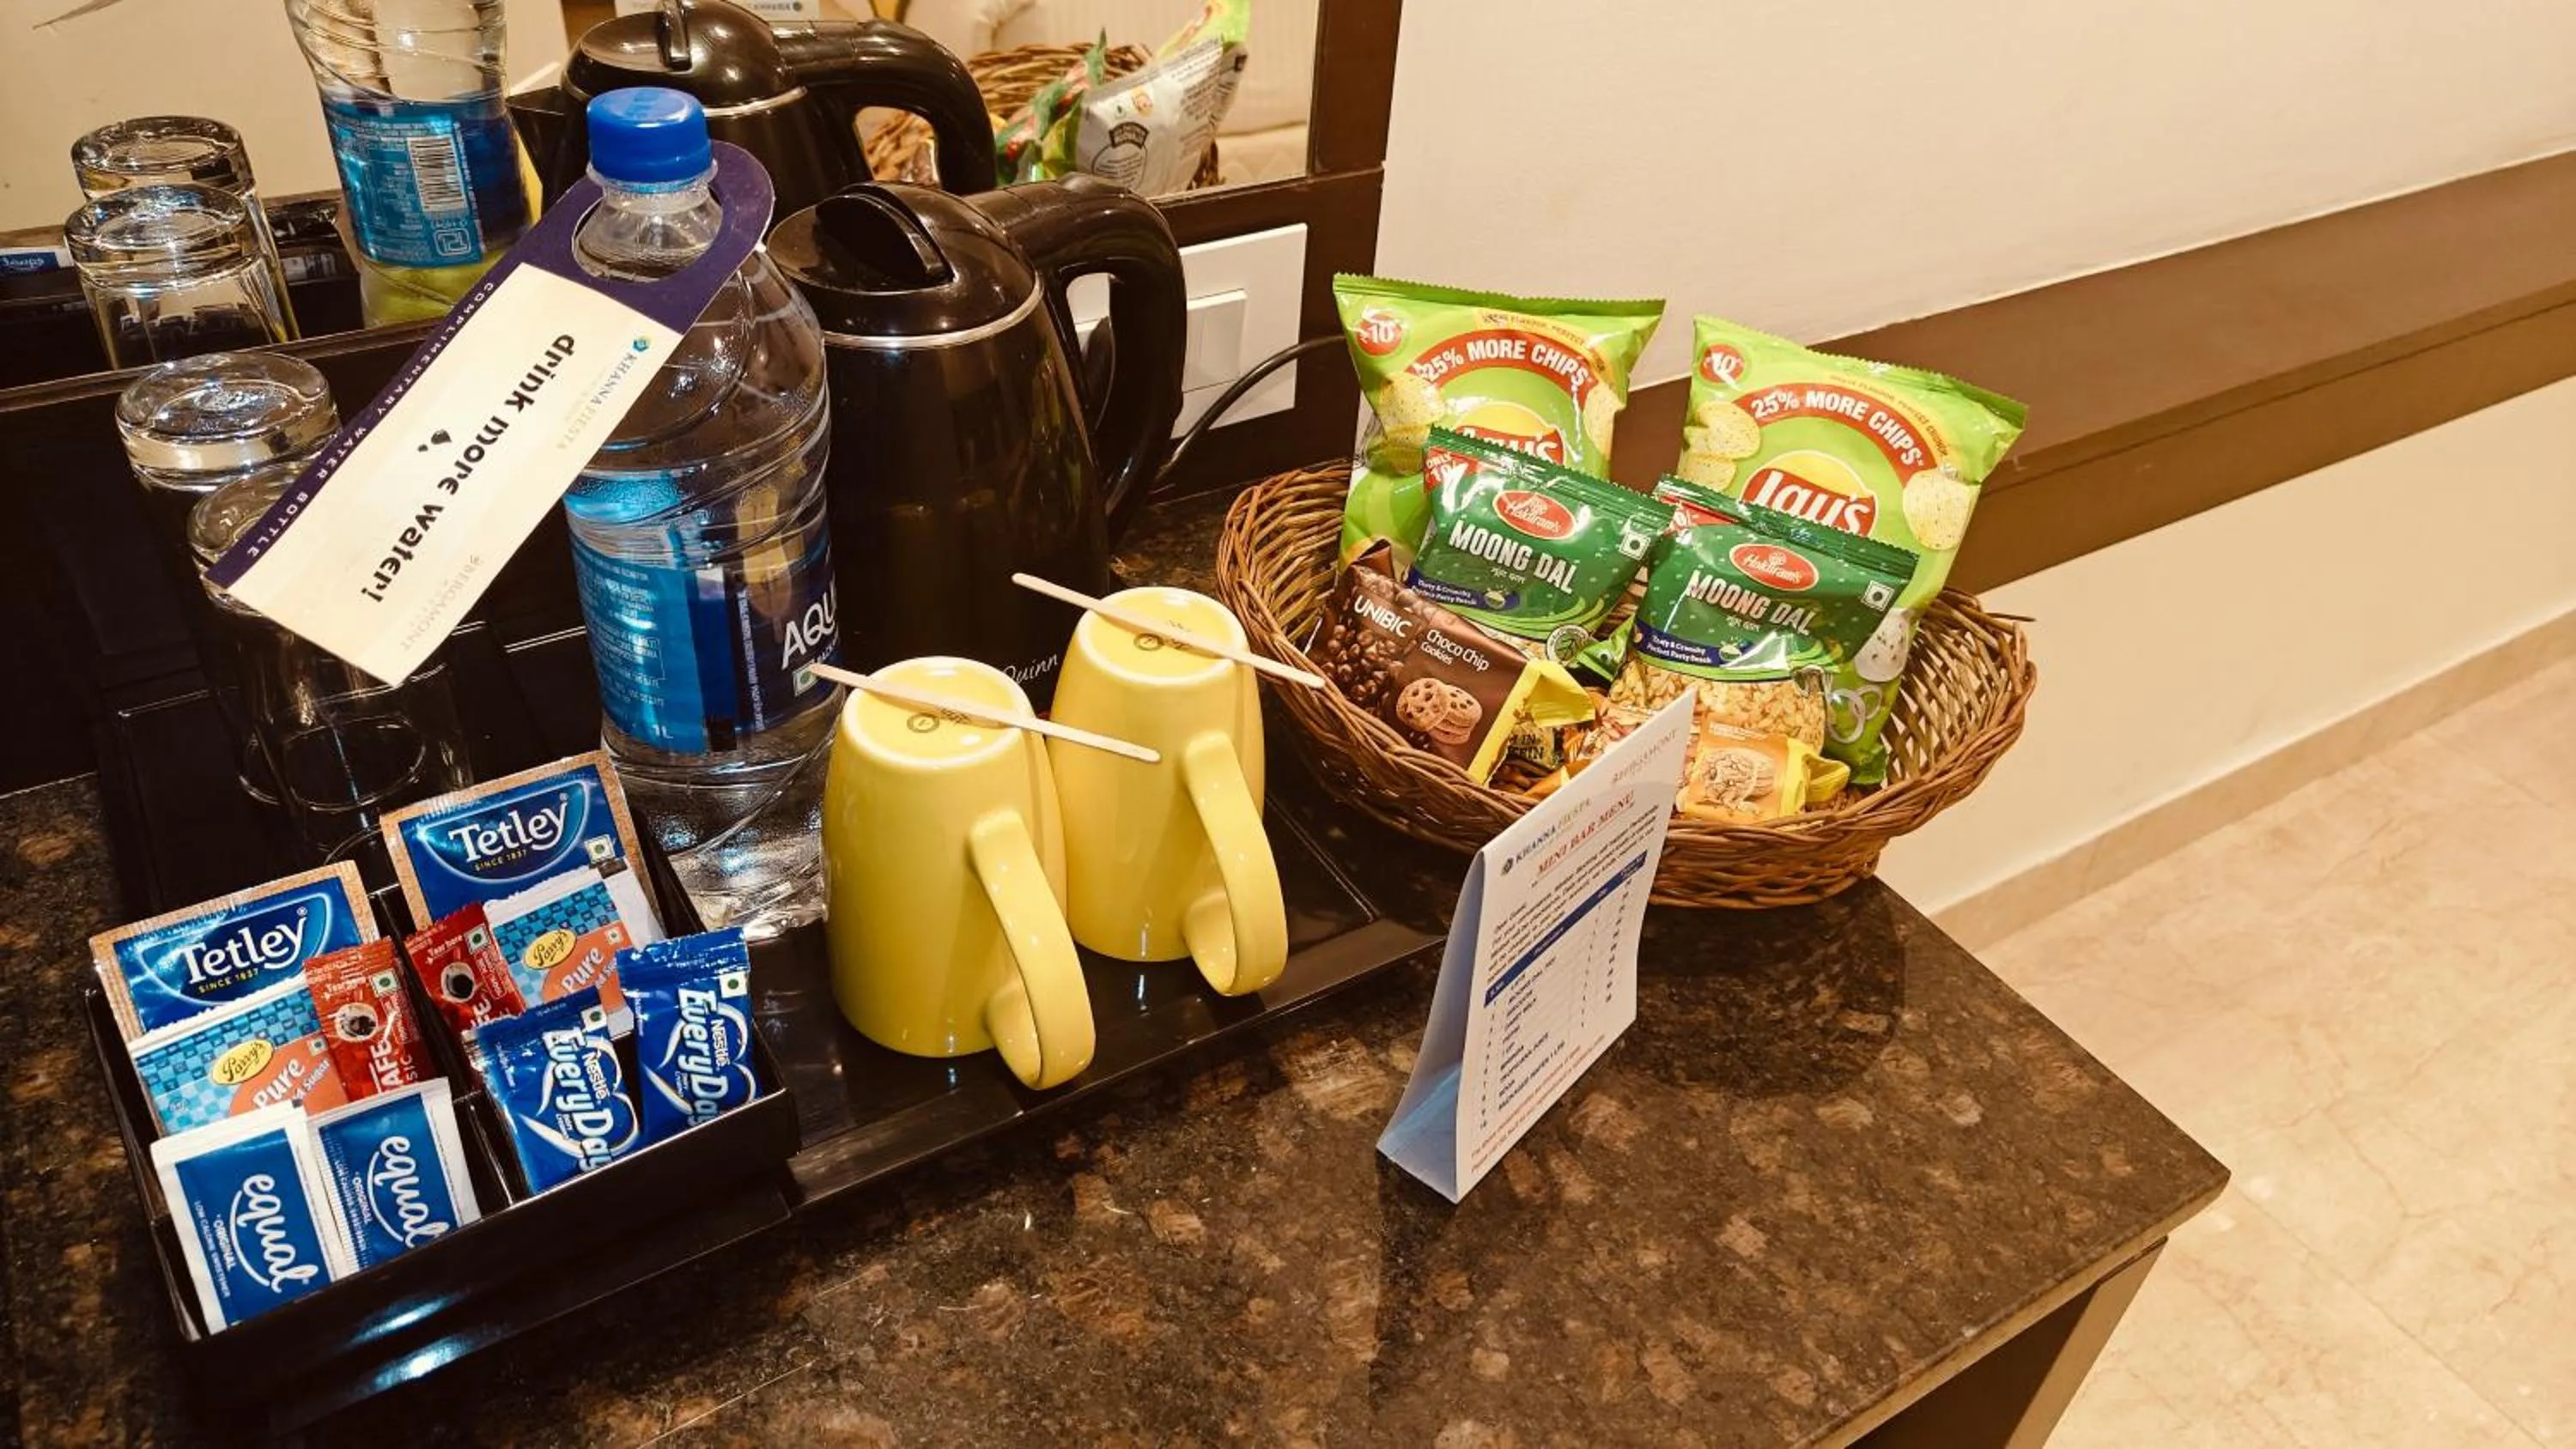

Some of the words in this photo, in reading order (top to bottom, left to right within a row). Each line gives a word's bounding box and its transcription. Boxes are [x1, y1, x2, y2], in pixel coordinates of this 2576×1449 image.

[373, 280, 495, 418] COMPLIMENTARY
[505, 333, 578, 415] drink
[1466, 339, 1527, 361] MORE
[1531, 343, 1589, 387] CHIPS
[590, 352, 638, 408] KHANNA
[314, 426, 367, 481] WATER
[1751, 389, 1801, 419] 25%
[1805, 390, 1869, 421] MORE
[1868, 411, 1923, 465] CHIPS
[436, 416, 510, 496] more
[246, 491, 308, 560] BOTTLE
[361, 501, 445, 604] water!
[1449, 519, 1534, 572] MOONG
[1534, 551, 1580, 594] DAL
[1353, 595, 1413, 639] UNIBIC
[1686, 570, 1772, 621] MOONG
[1769, 603, 1817, 635] DAL
[1420, 641, 1454, 666] Cookies
[1426, 629, 1461, 657] Choco
[1461, 648, 1490, 672] Chip
[448, 803, 568, 862] Tetley
[474, 857, 504, 872] SINCE
[179, 916, 307, 985] Tetley
[561, 947, 605, 994] Pure
[198, 978, 233, 994] SINCE
[710, 1018, 732, 1072] Nestlé
[252, 1057, 305, 1111] Pure
[543, 1028, 615, 1172] EveryDay
[581, 1050, 611, 1102] Nestlé
[352, 1176, 374, 1224] ORIGINAL
[374, 1136, 450, 1248] equal
[212, 1219, 238, 1270] ORIGINAL
[235, 1173, 319, 1294] equal
